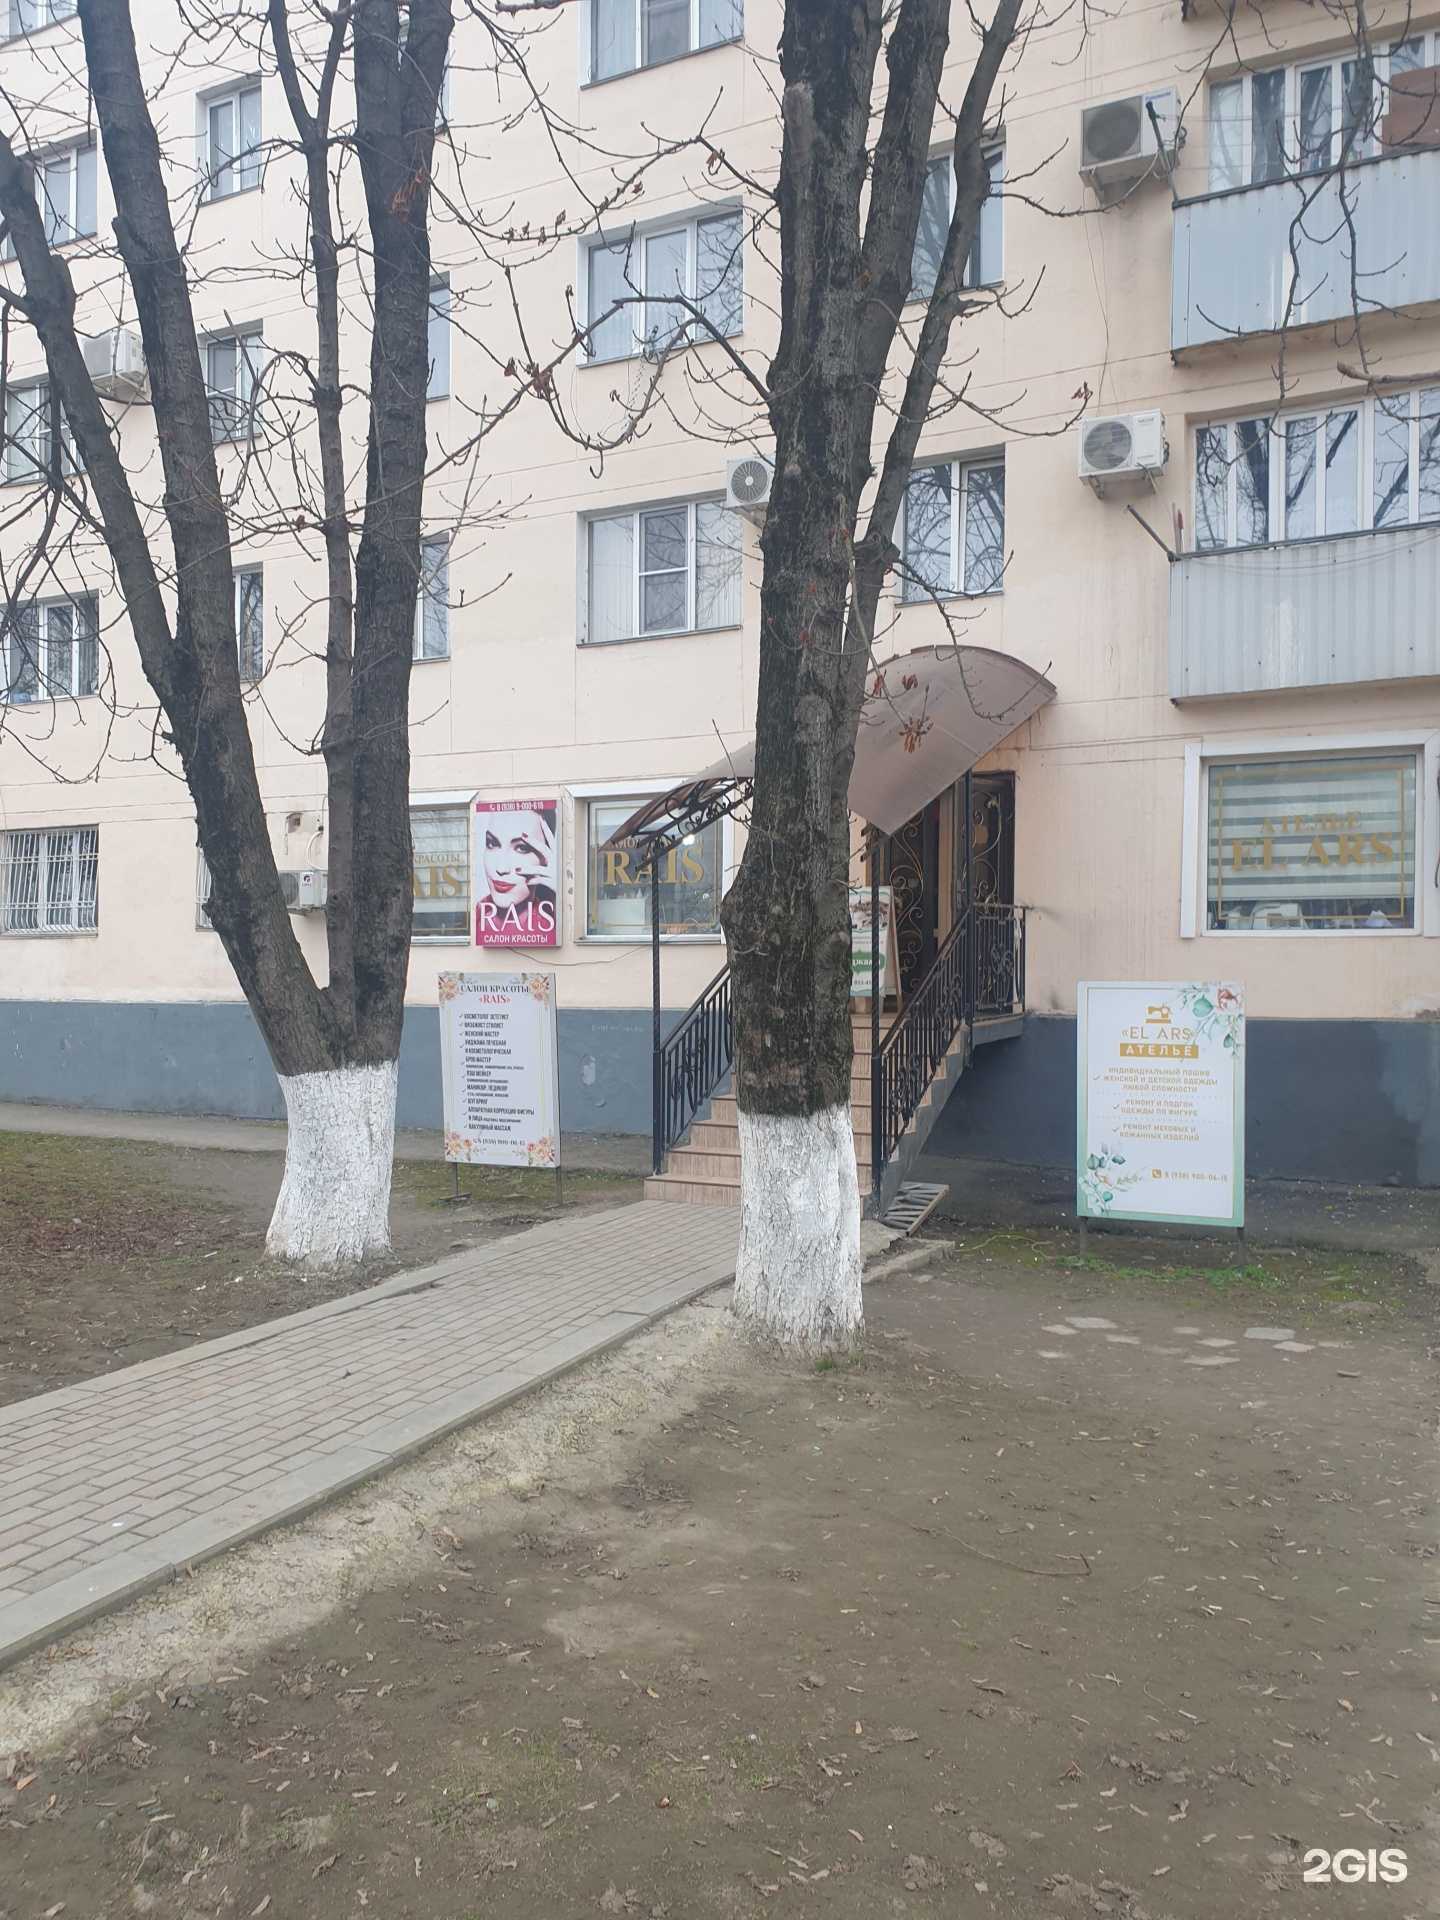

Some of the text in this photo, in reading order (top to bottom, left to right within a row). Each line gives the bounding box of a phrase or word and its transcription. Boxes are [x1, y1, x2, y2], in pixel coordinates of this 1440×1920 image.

[1303, 832, 1394, 866] ARS
[480, 901, 555, 932] RAIS
[484, 934, 548, 943] САЛОН КРАСОТЫ
[460, 984, 529, 993] САЛОН КРАСОТЫ
[479, 994, 511, 1004] «RAIS»
[1126, 1044, 1193, 1057] АТЕЛЬЕ
[1108, 1067, 1181, 1076] ИНДИВИДУАЛЬНЫЙ
[1104, 1074, 1138, 1083] ЖЕНСКОЙ
[1148, 1077, 1182, 1086] ДЕТСКОЙ
[1184, 1078, 1218, 1087] ОДЕЖДЫ
[1151, 1085, 1199, 1093] СЛОЖНОСТИ
[1126, 1099, 1154, 1107] РЕМОНТ
[1121, 1106, 1154, 1116] ОДЕЖДЫ
[1168, 1109, 1198, 1117] ФИГУРЕ
[1122, 1124, 1152, 1132] РЕМОНТ
[1153, 1125, 1189, 1133] МЕХОВЫХ
[1119, 1131, 1200, 1142] КОЖАННЫХ ИЗДЕЛИЙ
